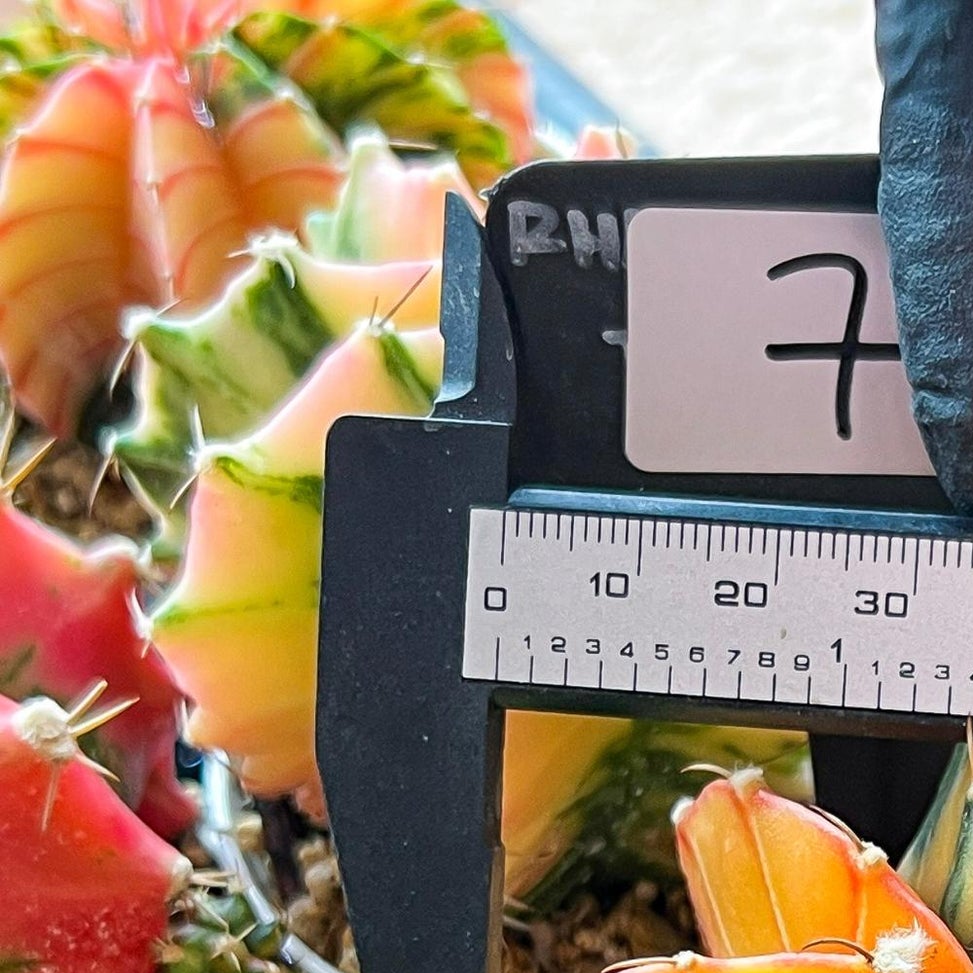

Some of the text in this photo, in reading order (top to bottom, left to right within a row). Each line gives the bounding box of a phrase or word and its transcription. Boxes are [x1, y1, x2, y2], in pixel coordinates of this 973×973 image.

[507, 200, 640, 272] RH
[483, 586, 508, 612] 0
[589, 571, 630, 599] 10
[713, 579, 768, 608] 20
[853, 589, 909, 618] 30
[523, 634, 531, 650] 1
[550, 635, 567, 654] 2
[585, 638, 601, 655] 3
[619, 641, 634, 659] 4
[654, 643, 670, 661] 5
[689, 646, 705, 664] 6
[727, 649, 742, 665] 7
[757, 651, 776, 669] 8
[793, 654, 811, 672] 9
[830, 637, 842, 664] 1
[871, 660, 879, 676] 1
[898, 661, 916, 679] 2
[934, 664, 950, 680] 3
